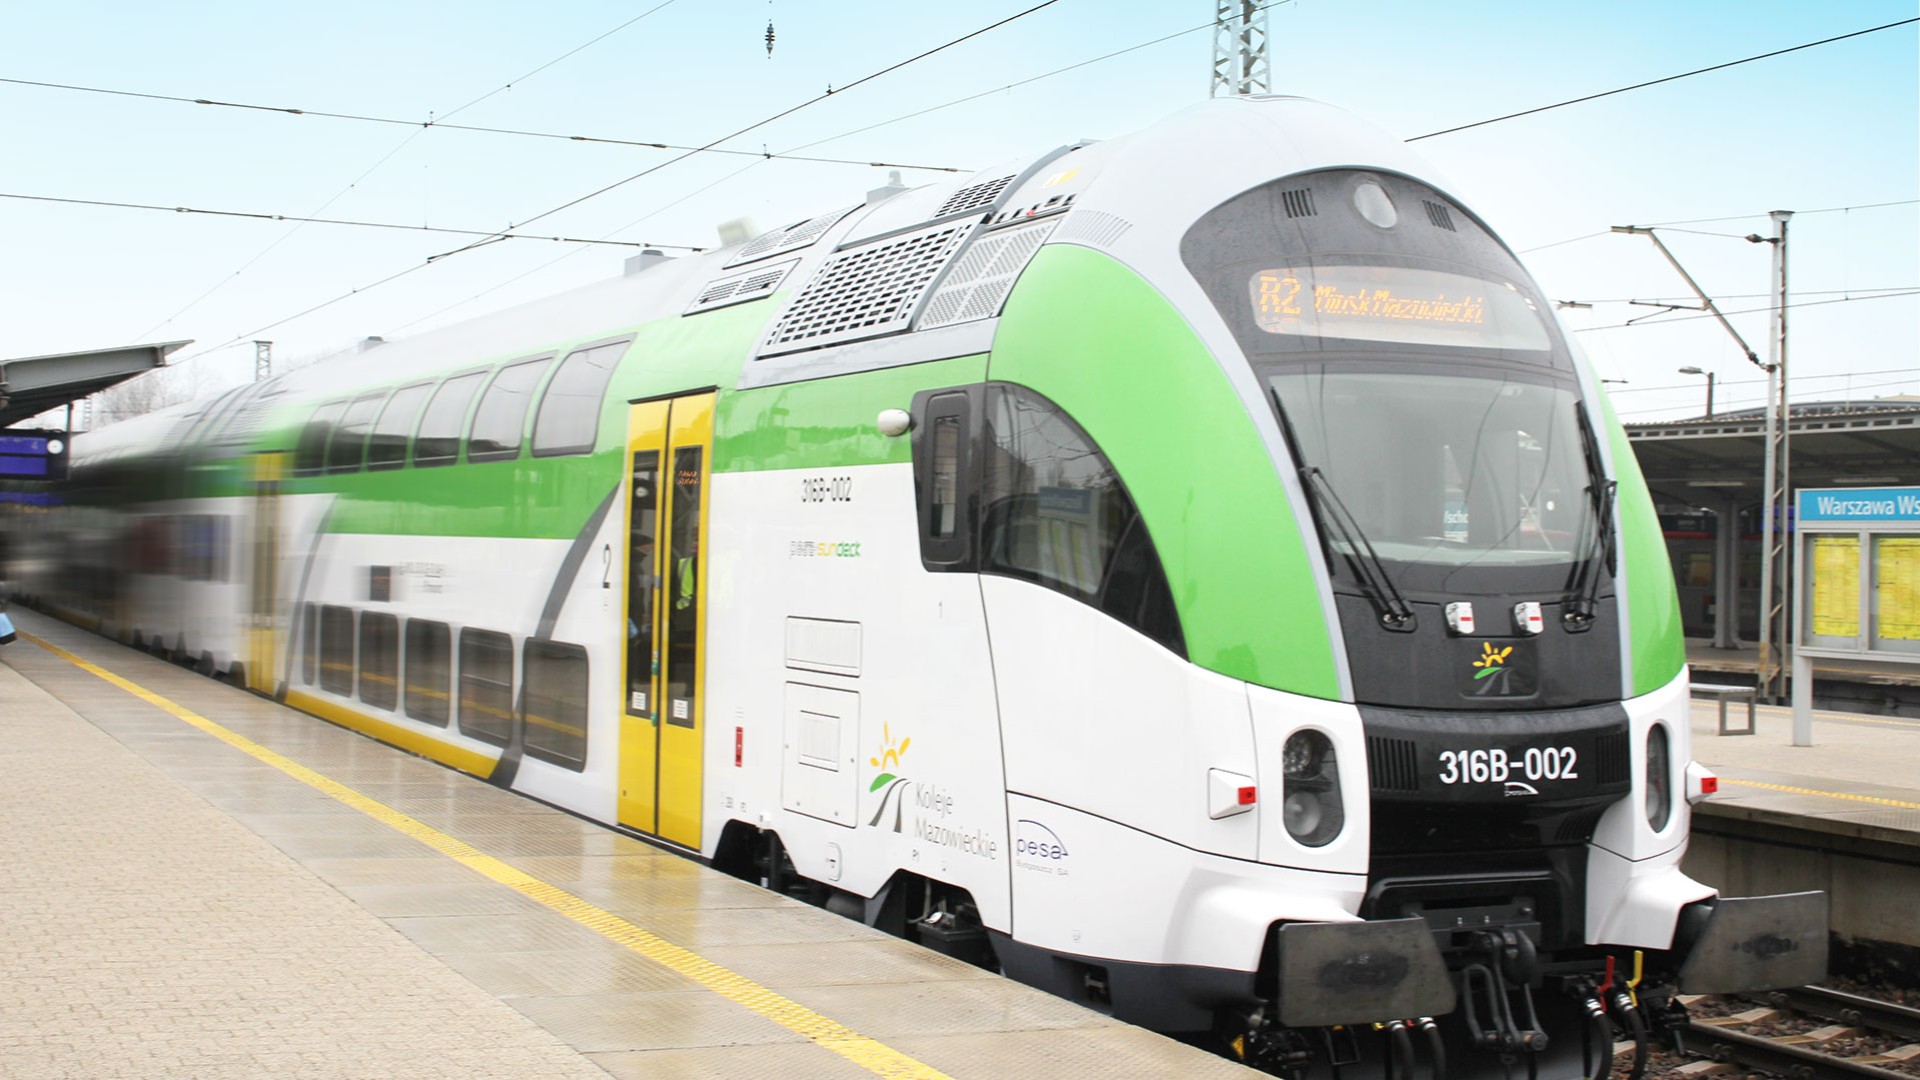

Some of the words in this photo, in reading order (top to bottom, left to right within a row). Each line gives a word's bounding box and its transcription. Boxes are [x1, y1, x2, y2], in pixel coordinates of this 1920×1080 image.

[1259, 275, 1301, 314] R2
[801, 476, 853, 503] 316B-002
[1817, 495, 1896, 516] Warszawa
[602, 543, 612, 589] 2
[817, 541, 861, 558] sundeck
[1438, 746, 1578, 785] 316B-002
[914, 782, 953, 819] Koleje
[914, 816, 998, 861] Mazowieckie
[1016, 838, 1064, 860] pesa
